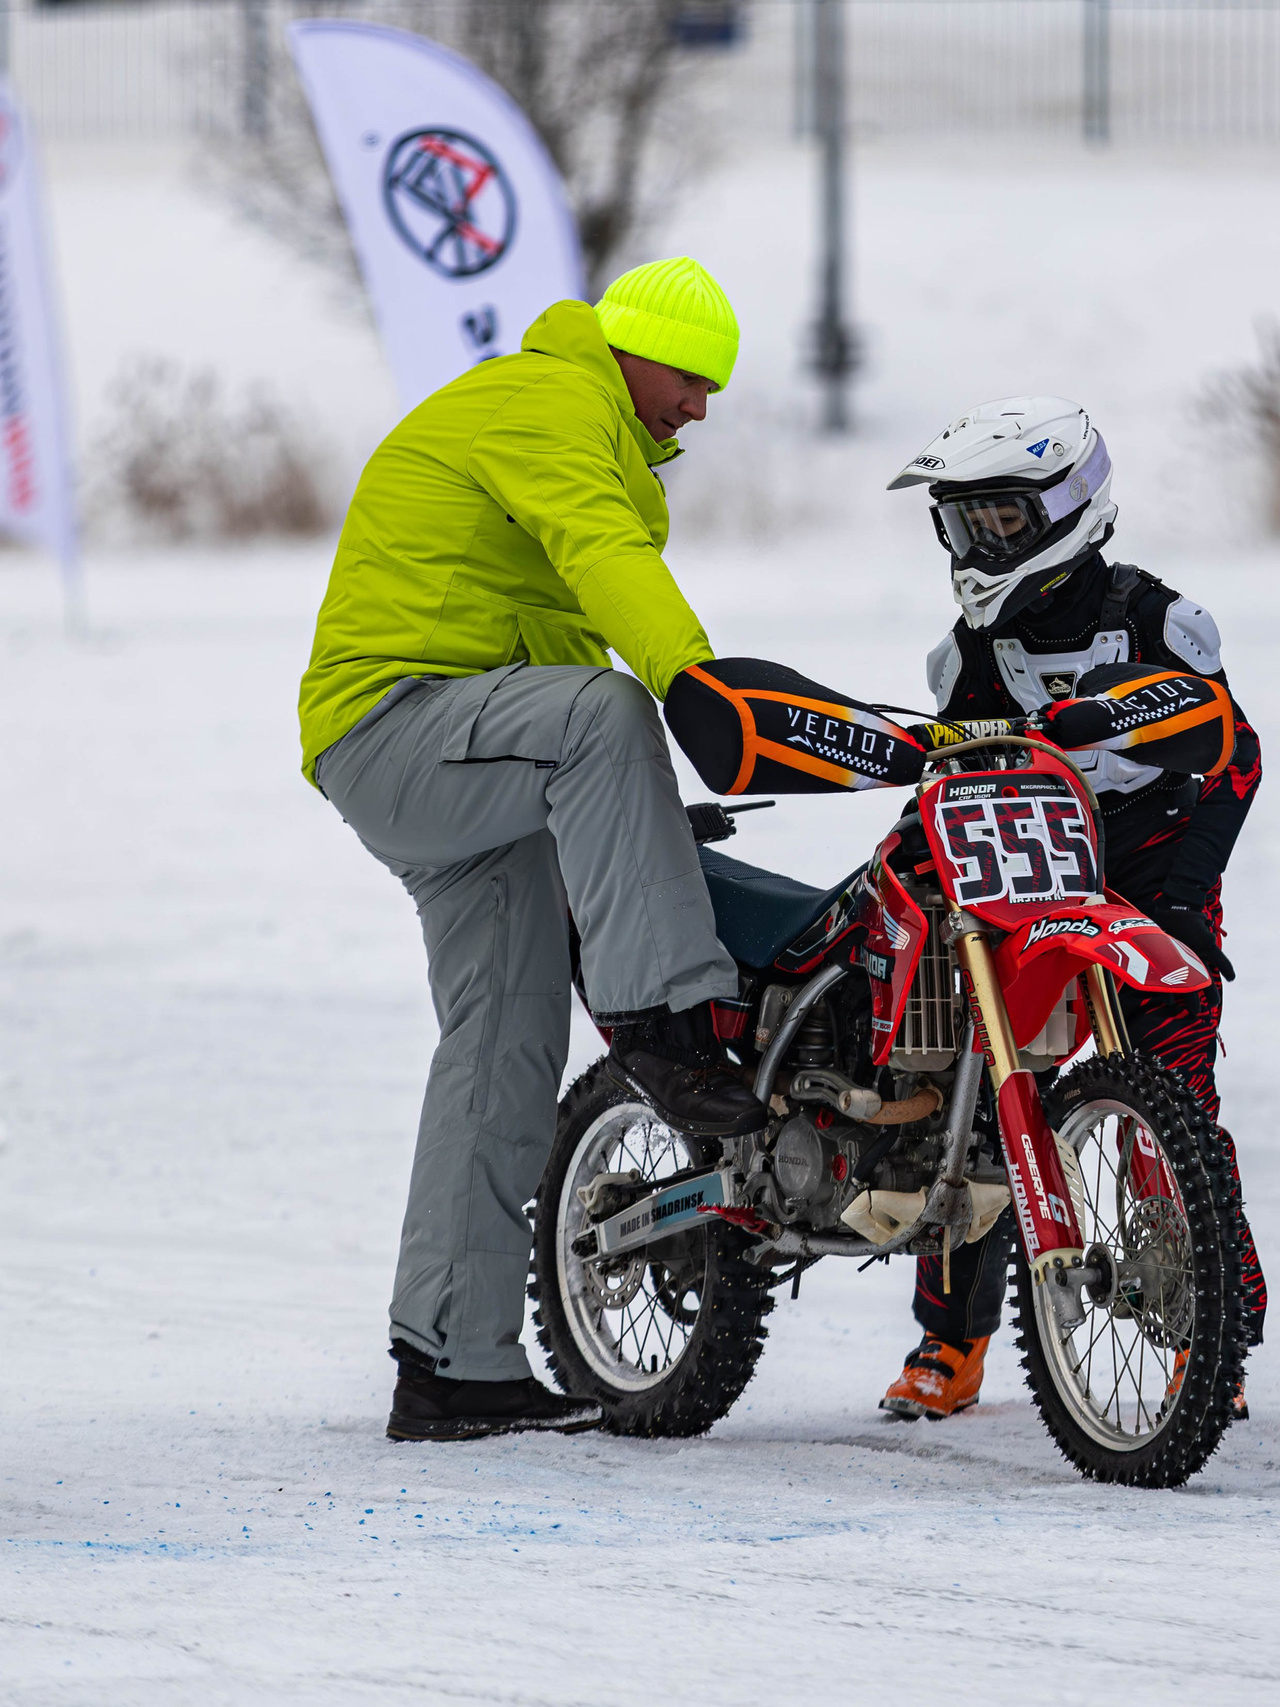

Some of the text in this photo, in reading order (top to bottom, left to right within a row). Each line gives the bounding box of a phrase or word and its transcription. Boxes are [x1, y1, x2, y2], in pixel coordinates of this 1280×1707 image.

[911, 457, 940, 469] OEI
[786, 706, 895, 762] VECTOR
[949, 783, 997, 798] HONDA
[935, 796, 1097, 906] 555
[1022, 919, 1099, 951] Honda
[620, 1190, 705, 1238] MADE IN SHADRINSK
